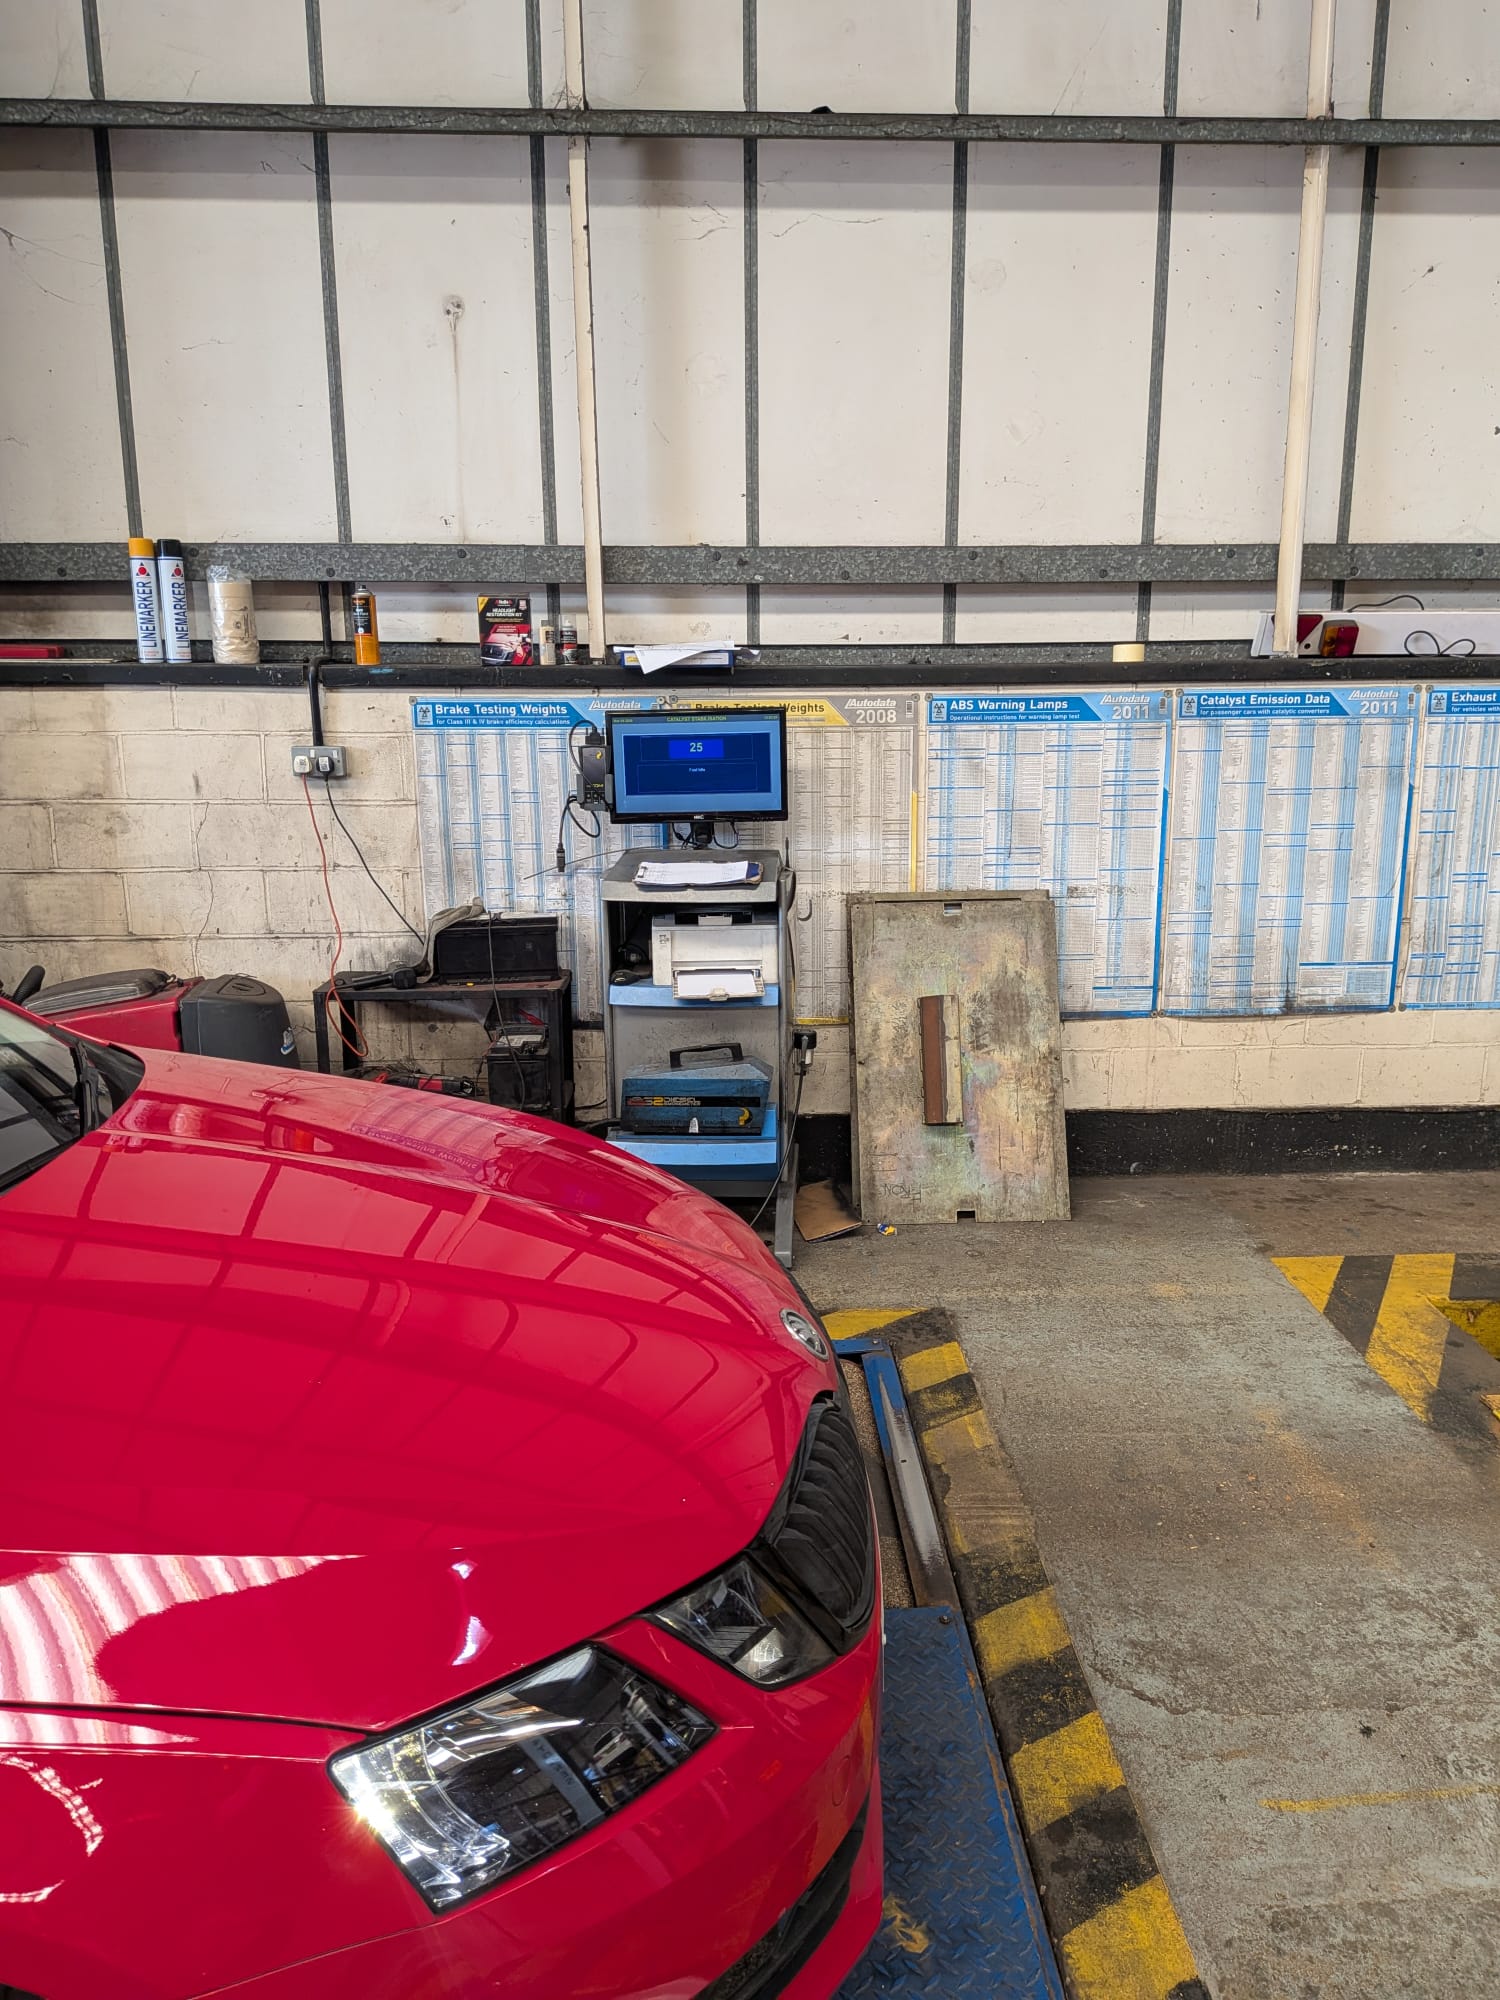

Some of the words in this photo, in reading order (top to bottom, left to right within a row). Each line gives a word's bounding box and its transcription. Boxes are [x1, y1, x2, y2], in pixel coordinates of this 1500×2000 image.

[136, 581, 157, 648] LINEMARKER
[172, 582, 190, 649] LINEMARKER
[1100, 694, 1150, 704] Autodata
[1200, 694, 1246, 707] Catalyst
[1250, 693, 1301, 705] Emission
[1305, 693, 1330, 704] Data
[1348, 690, 1399, 700] Autodata
[1451, 691, 1498, 702] Exhaust
[435, 704, 470, 714] Brake
[474, 704, 516, 717] Testing
[520, 704, 568, 717] Weights
[589, 700, 641, 710] Autodata
[845, 699, 897, 709] Autodata
[950, 700, 974, 710] ABS
[978, 699, 1025, 712] Warning
[1030, 699, 1068, 712] Lamps
[1359, 700, 1398, 715] 2011
[856, 709, 897, 724] 2008
[1028, 713, 1051, 721] warning
[1111, 705, 1149, 719] 2011
[689, 742, 703, 752] 25
